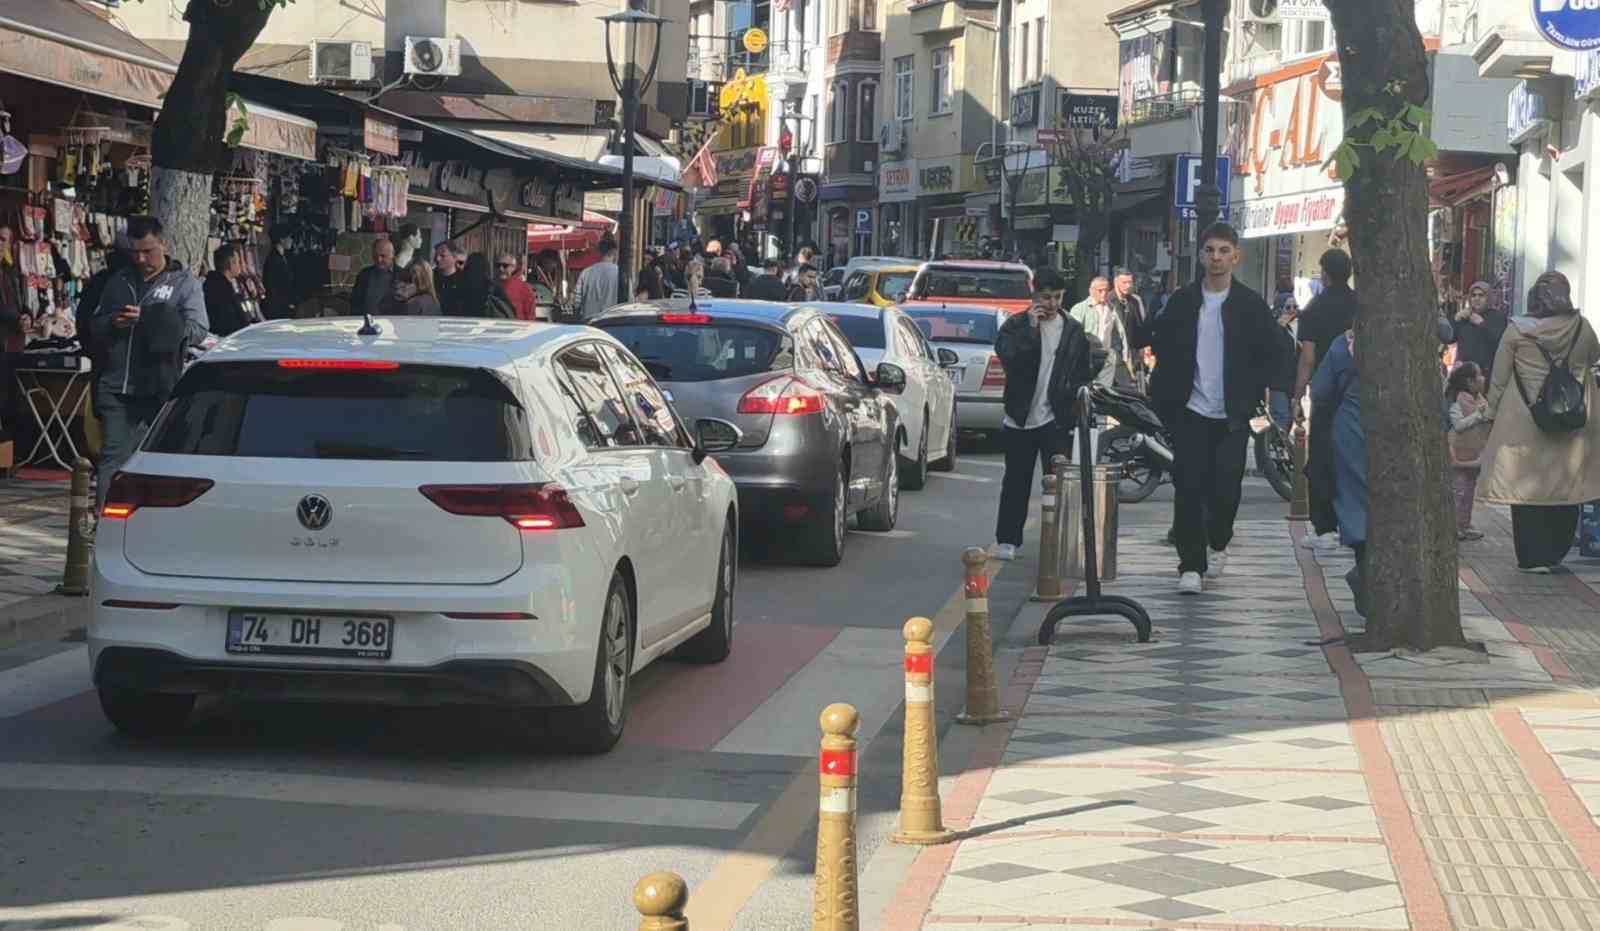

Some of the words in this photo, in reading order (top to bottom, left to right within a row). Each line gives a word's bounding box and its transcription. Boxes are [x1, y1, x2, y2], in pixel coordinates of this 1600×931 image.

[857, 211, 869, 228] P
[1272, 200, 1300, 229] Uygun
[1300, 193, 1336, 227] Fiyatlar
[244, 616, 268, 642] 74
[290, 618, 320, 645] DH
[342, 621, 387, 647] 368
